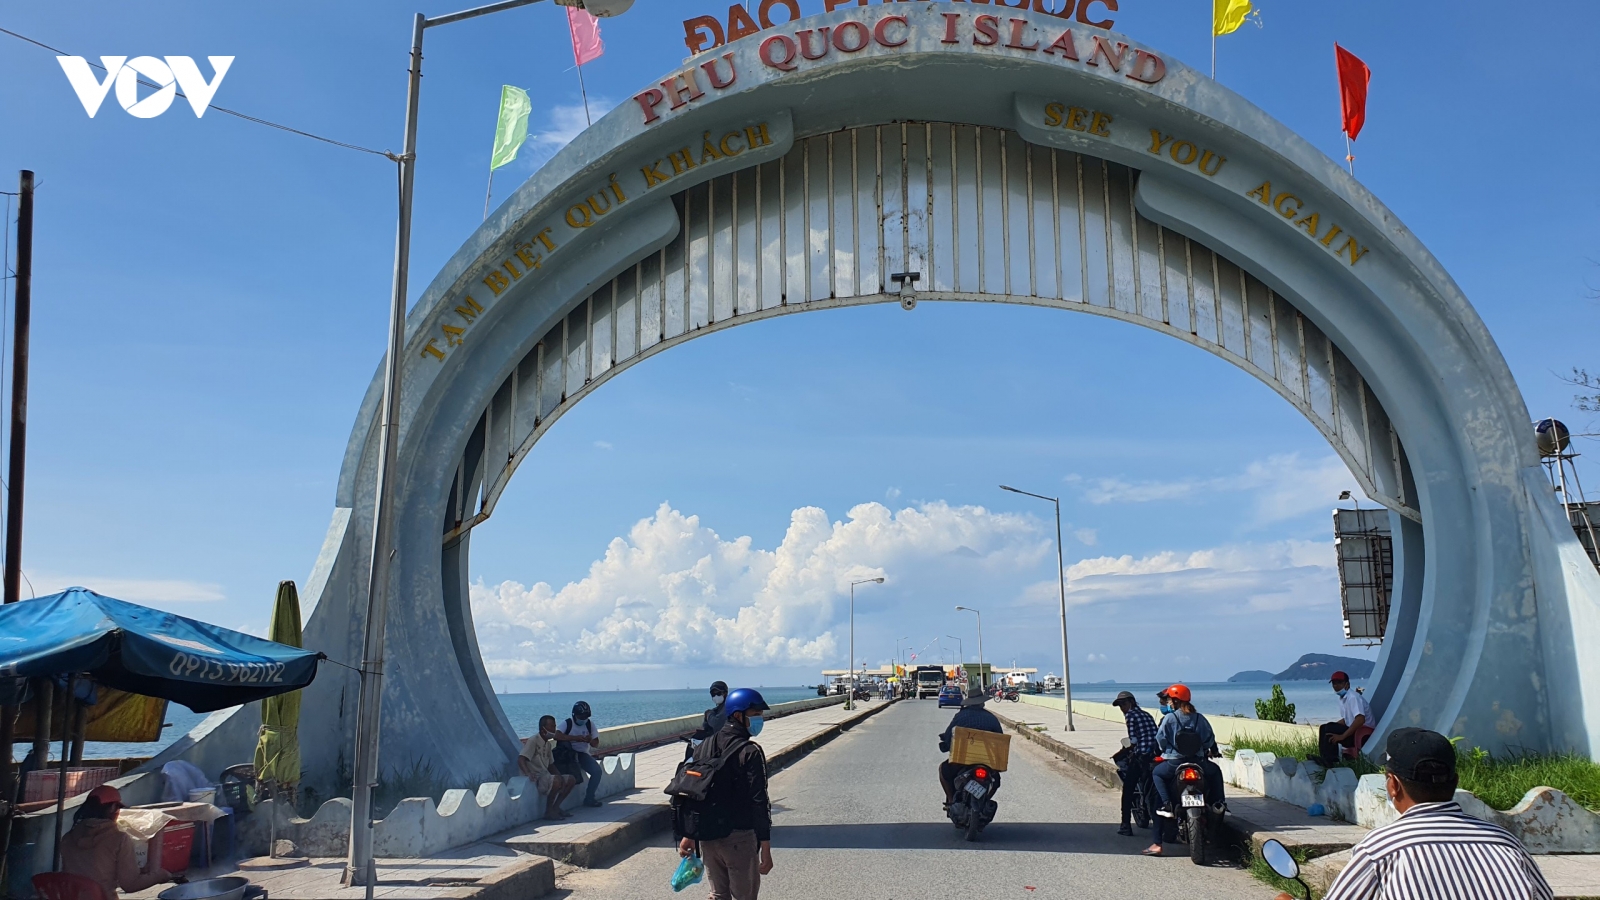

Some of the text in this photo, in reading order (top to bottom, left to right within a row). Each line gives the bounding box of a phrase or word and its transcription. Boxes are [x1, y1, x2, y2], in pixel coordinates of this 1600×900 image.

[633, 12, 1166, 125] PHU QUOC ISLAND
[421, 122, 773, 362] TẠM BIỆT QUÍ KHÁCH
[1044, 102, 1369, 266] SEE YOU AGAIN
